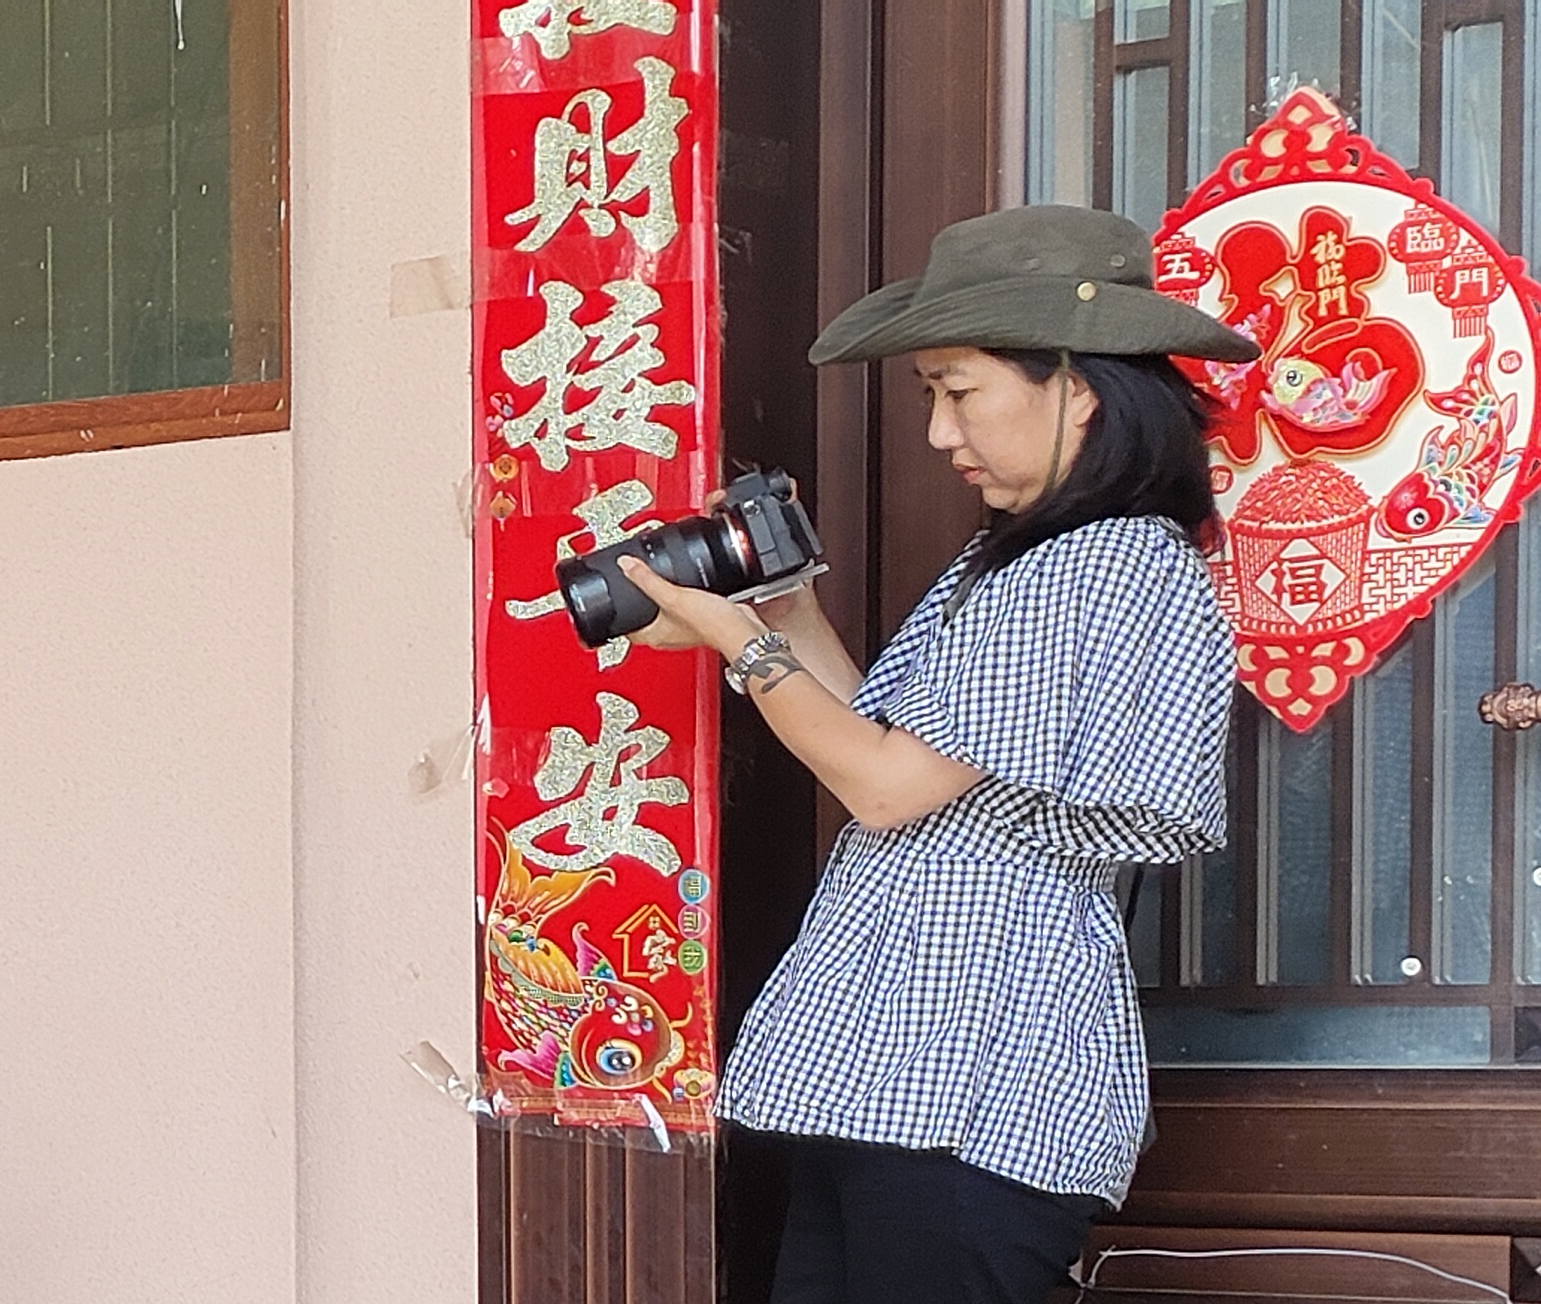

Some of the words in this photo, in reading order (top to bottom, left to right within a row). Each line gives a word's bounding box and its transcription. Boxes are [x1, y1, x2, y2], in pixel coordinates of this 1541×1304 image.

[1158, 252, 1200, 283] 五
[1449, 267, 1489, 300] 門
[1271, 556, 1329, 607] 福
